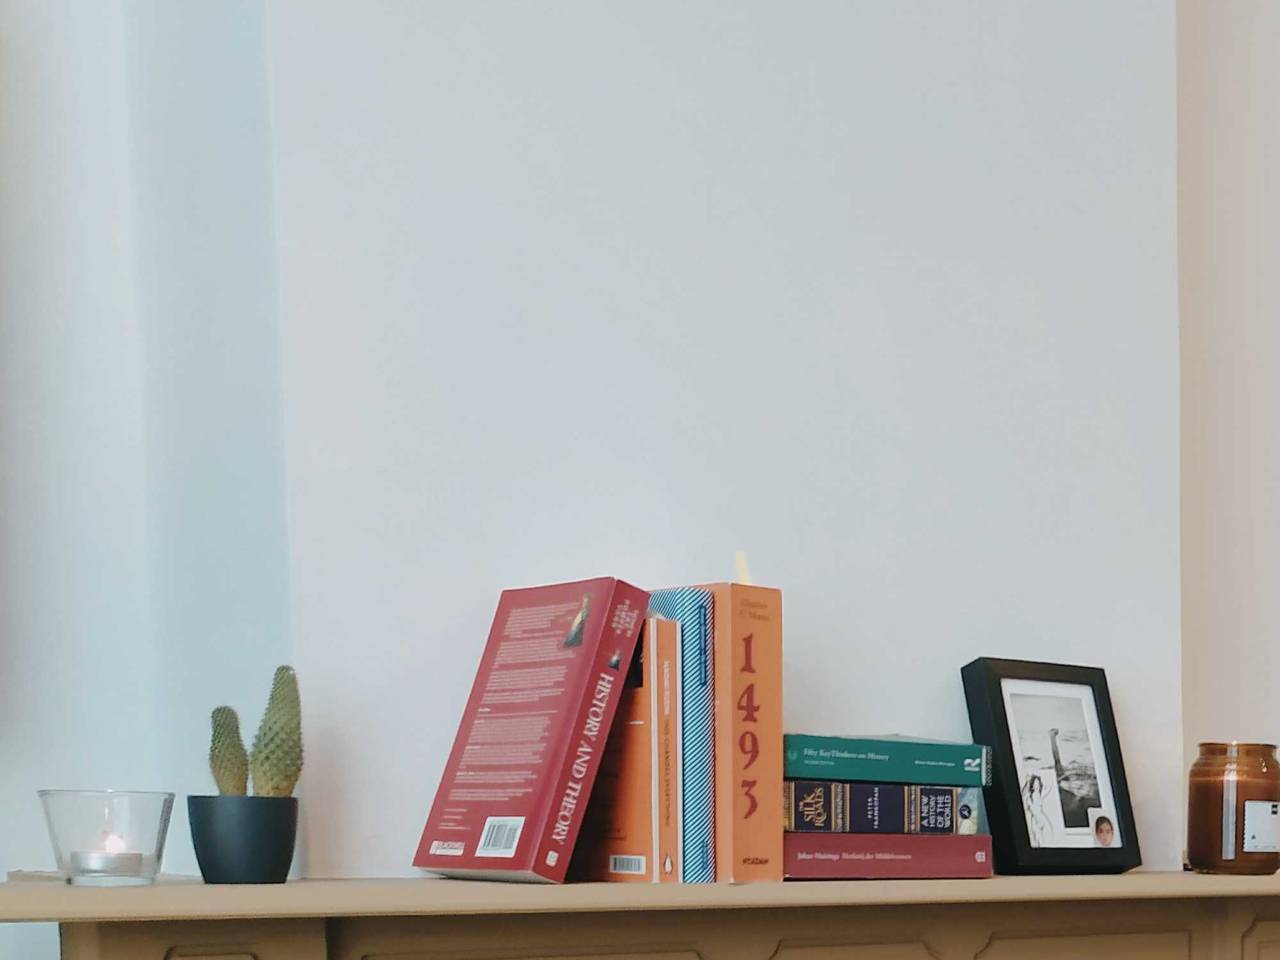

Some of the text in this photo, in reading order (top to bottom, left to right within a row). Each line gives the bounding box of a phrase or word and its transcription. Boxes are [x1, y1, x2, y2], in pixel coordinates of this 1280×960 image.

[552, 673, 614, 845] HISTORY AND THEORY
[804, 793, 816, 822] SILK
[814, 788, 827, 827] ROADS
[921, 795, 929, 827] A NEW
[936, 795, 944, 828] OF THE
